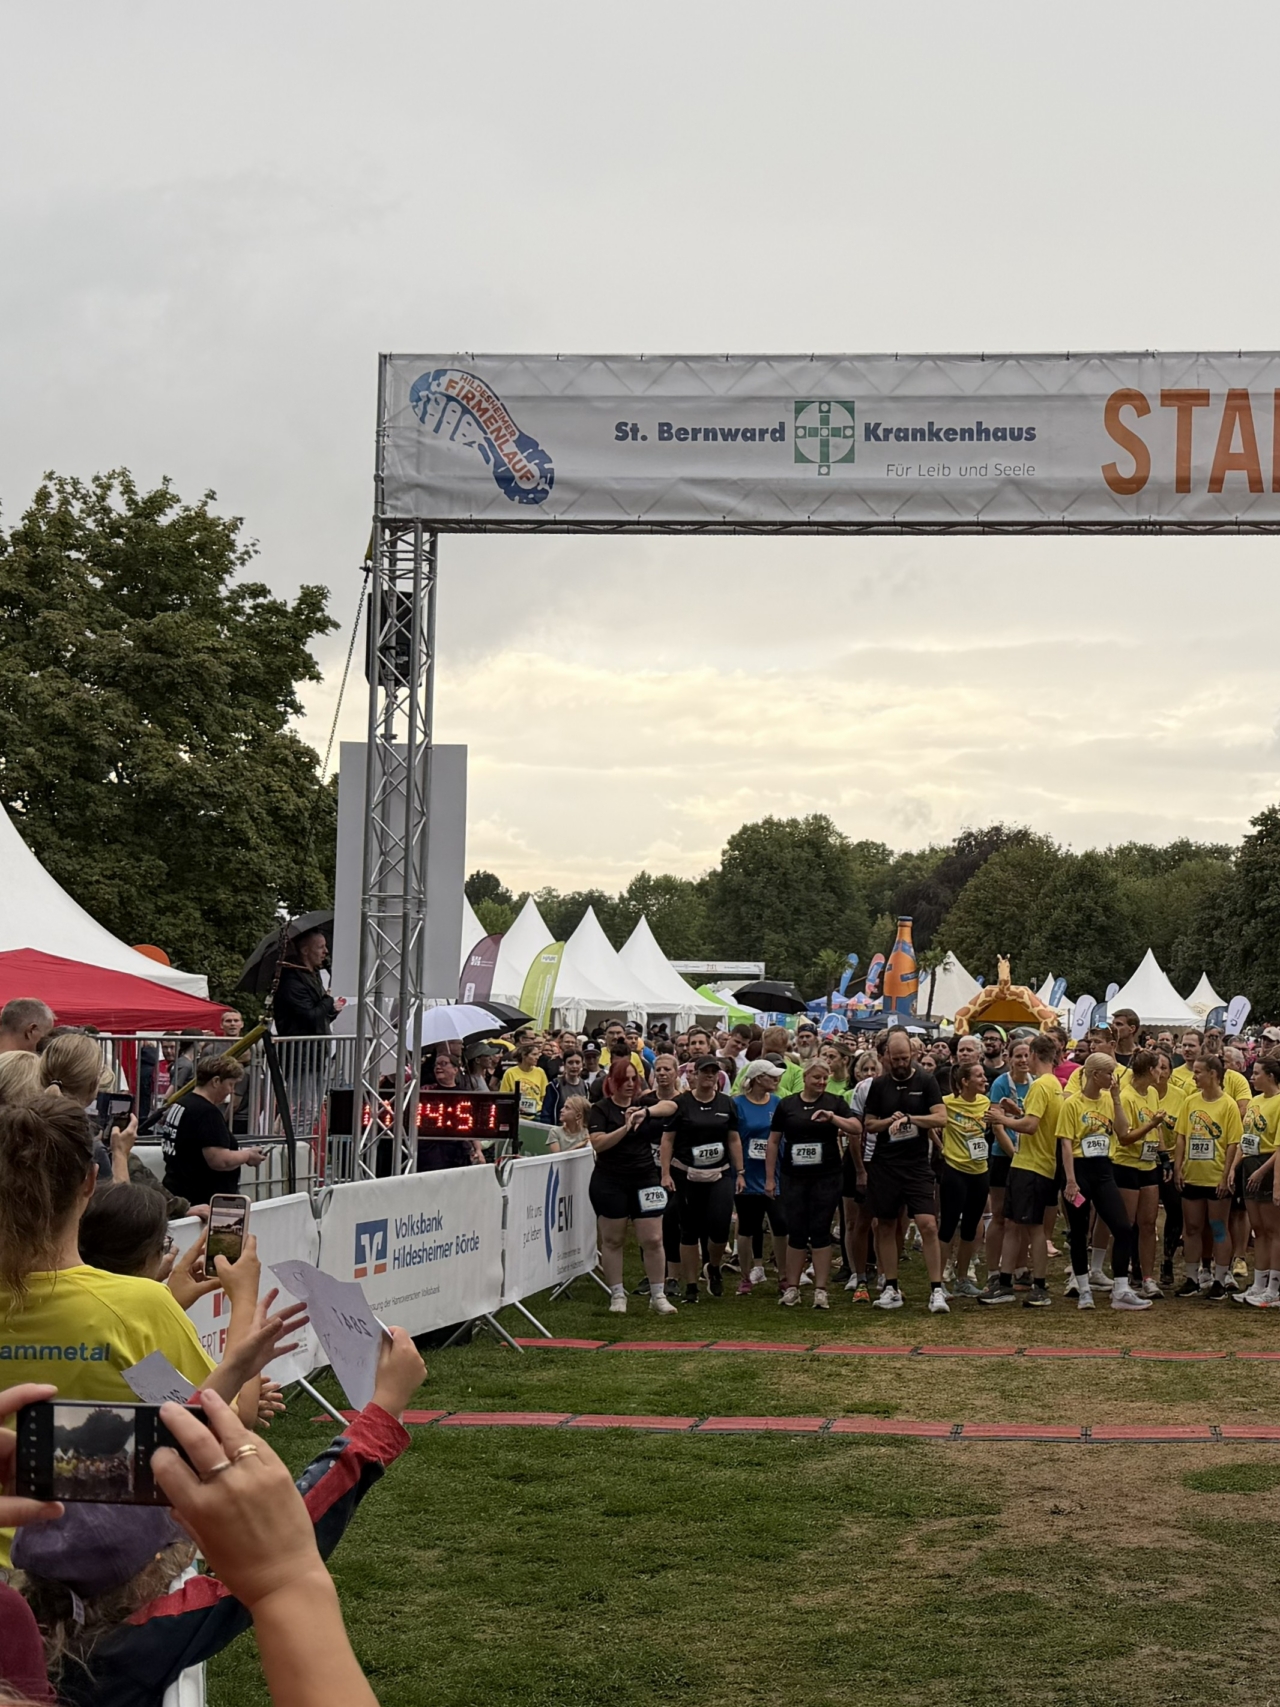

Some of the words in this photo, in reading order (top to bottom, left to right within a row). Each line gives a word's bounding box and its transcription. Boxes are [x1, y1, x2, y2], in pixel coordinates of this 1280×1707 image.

[459, 374, 517, 441] HILDESHEIMER
[444, 378, 535, 482] FIRMENLAUF
[614, 421, 648, 442] St.
[658, 421, 786, 442] Bernward
[864, 421, 1037, 443] Krankenhaus
[886, 463, 910, 478] Für
[918, 463, 952, 478] Leib
[959, 463, 988, 478] und
[994, 463, 1036, 478] Seele
[395, 1209, 444, 1240] Volksbank
[558, 1194, 573, 1233] EVI
[392, 1240, 454, 1271] Hildesheimer
[455, 1230, 480, 1256] Börde
[0, 1342, 111, 1362] ammetal
[197, 1331, 218, 1358] ERT
